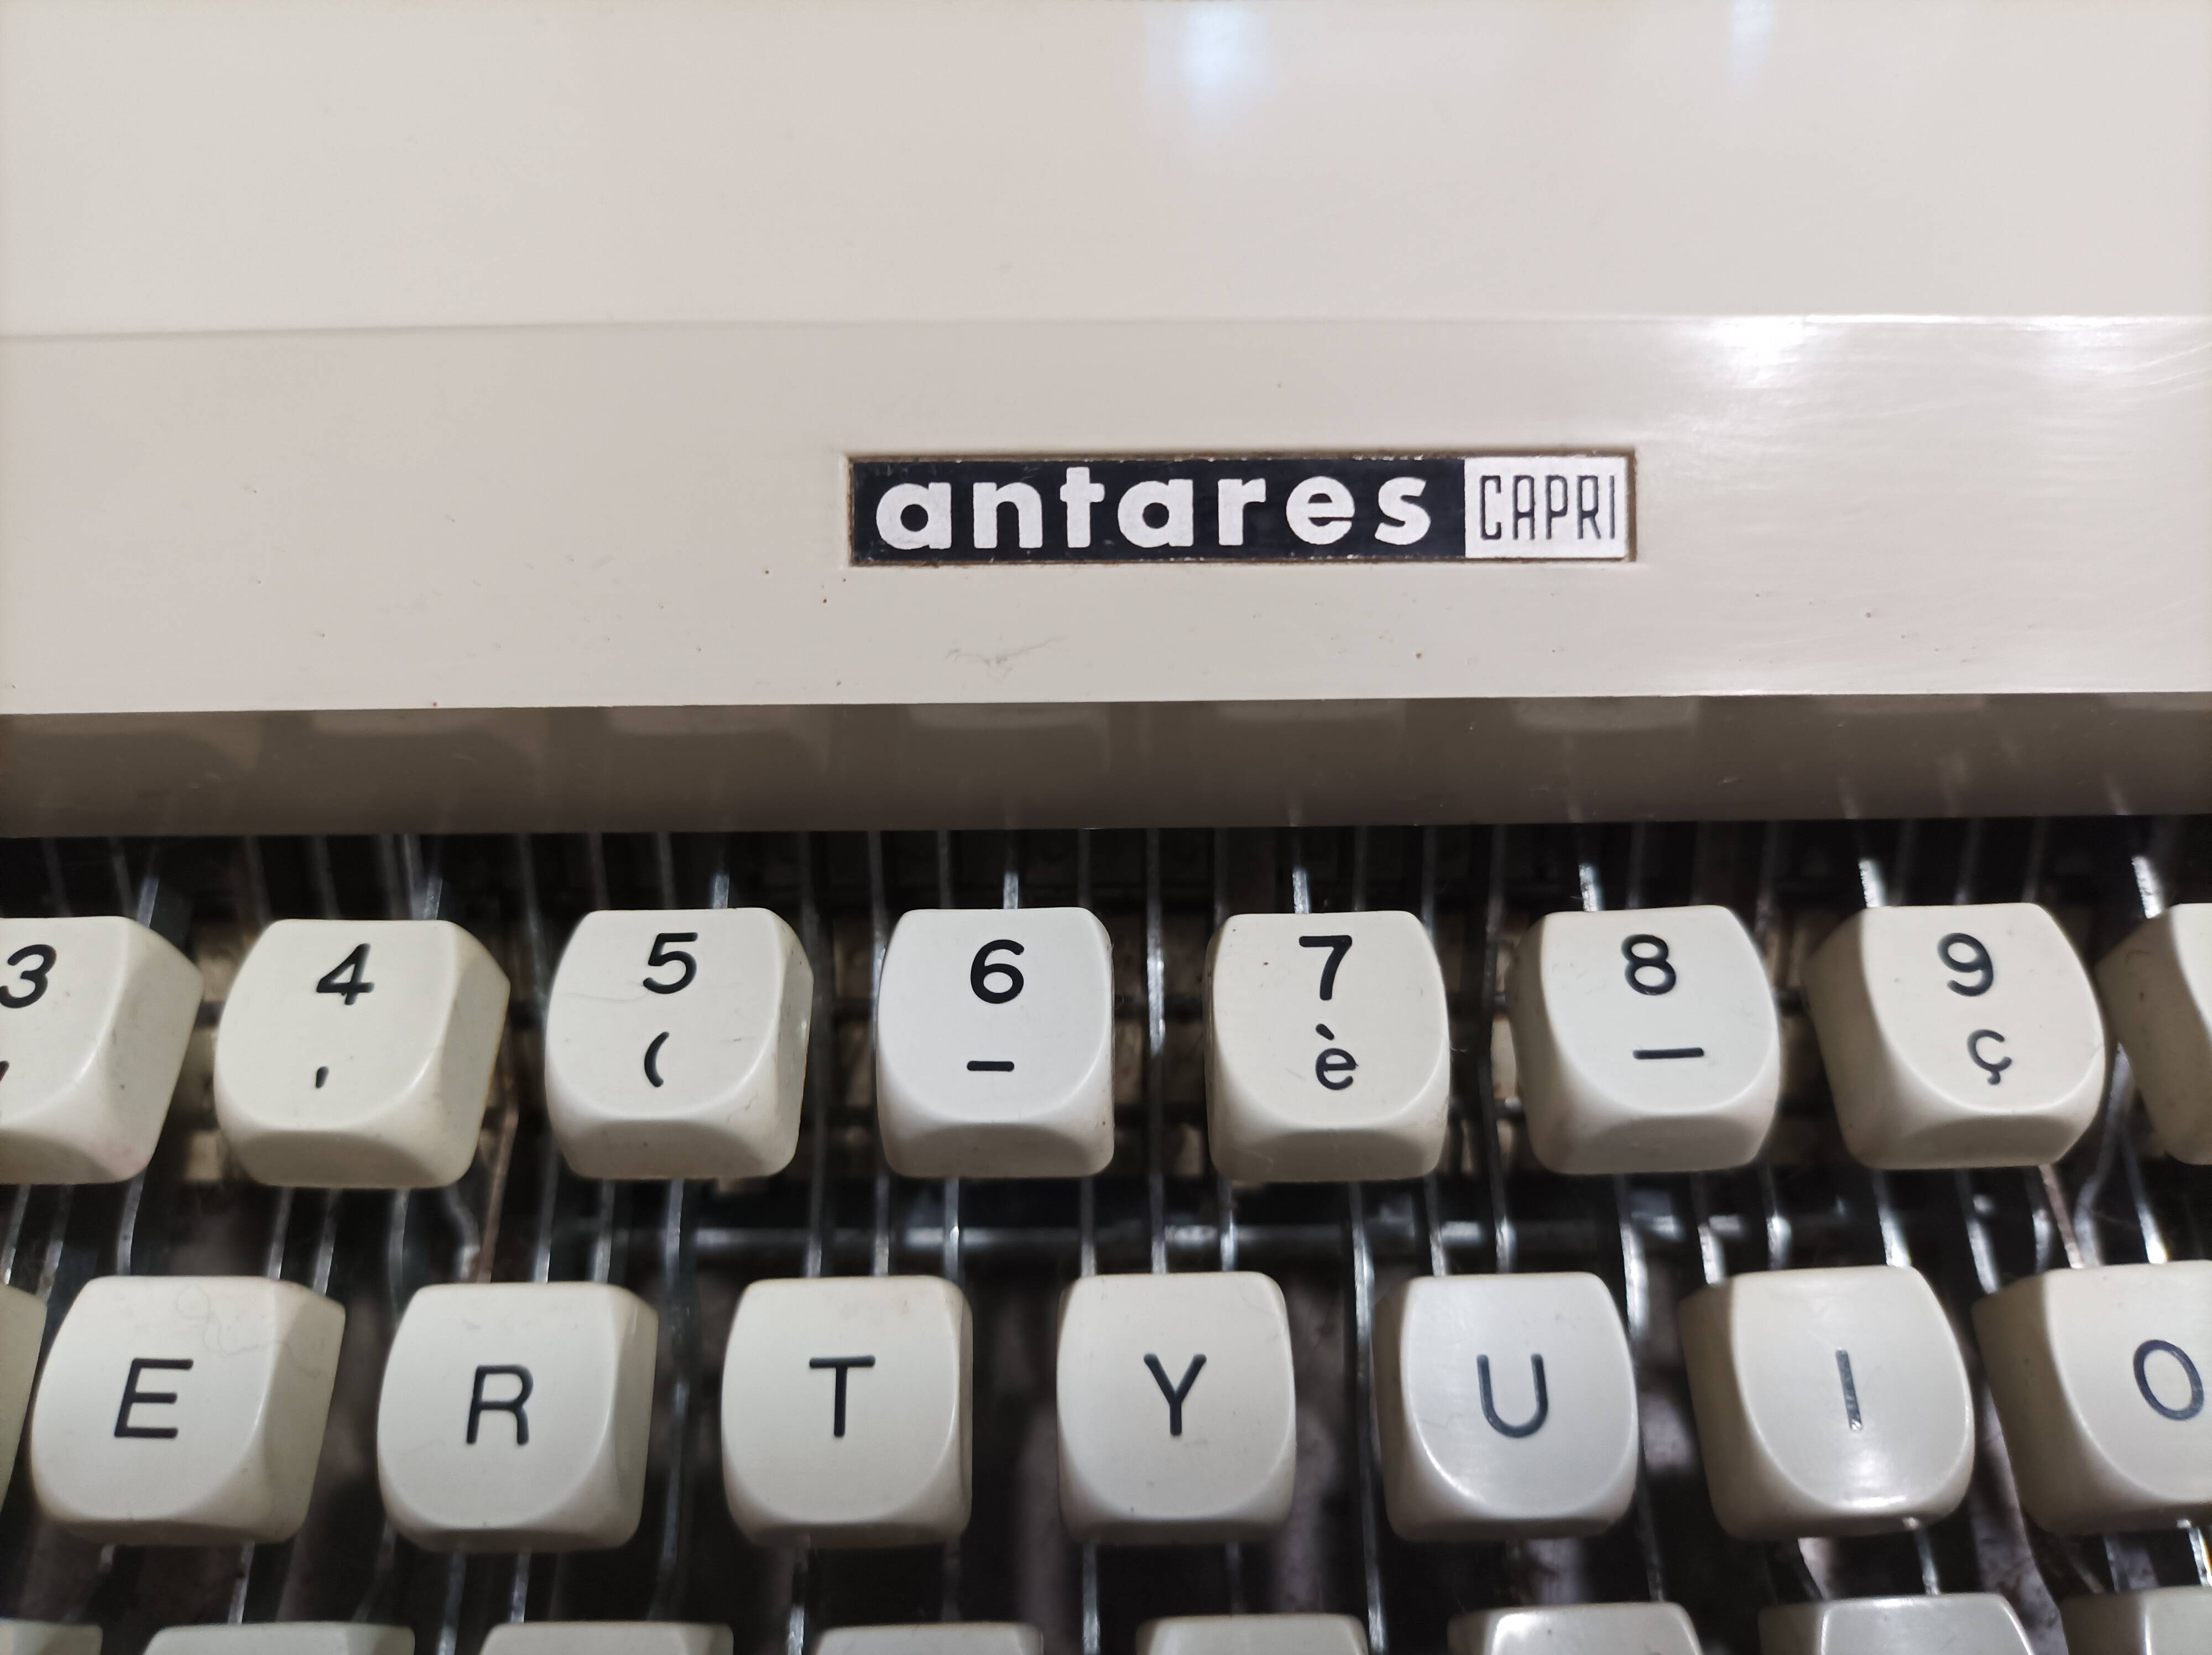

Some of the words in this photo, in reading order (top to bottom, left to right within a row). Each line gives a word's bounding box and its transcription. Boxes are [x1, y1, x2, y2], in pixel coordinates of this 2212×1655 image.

[877, 466, 1431, 549] antares
[1480, 475, 1615, 540] CAPRI
[0, 944, 56, 1008] 3
[316, 944, 373, 1005] 4
[643, 933, 697, 994] 5
[971, 939, 1024, 1004] 6
[1299, 935, 1352, 1001] 7
[1622, 934, 1676, 996] 8
[1939, 933, 1994, 997] 9
[1316, 1024, 1358, 1090] è
[1968, 1029, 2012, 1085] ç
[114, 1358, 193, 1439] E
[466, 1366, 533, 1446] R
[810, 1356, 875, 1438] T
[1144, 1355, 1206, 1437] Y
[1478, 1355, 1548, 1439] U
[1836, 1351, 1862, 1428] I
[2133, 1340, 2204, 1421] O
